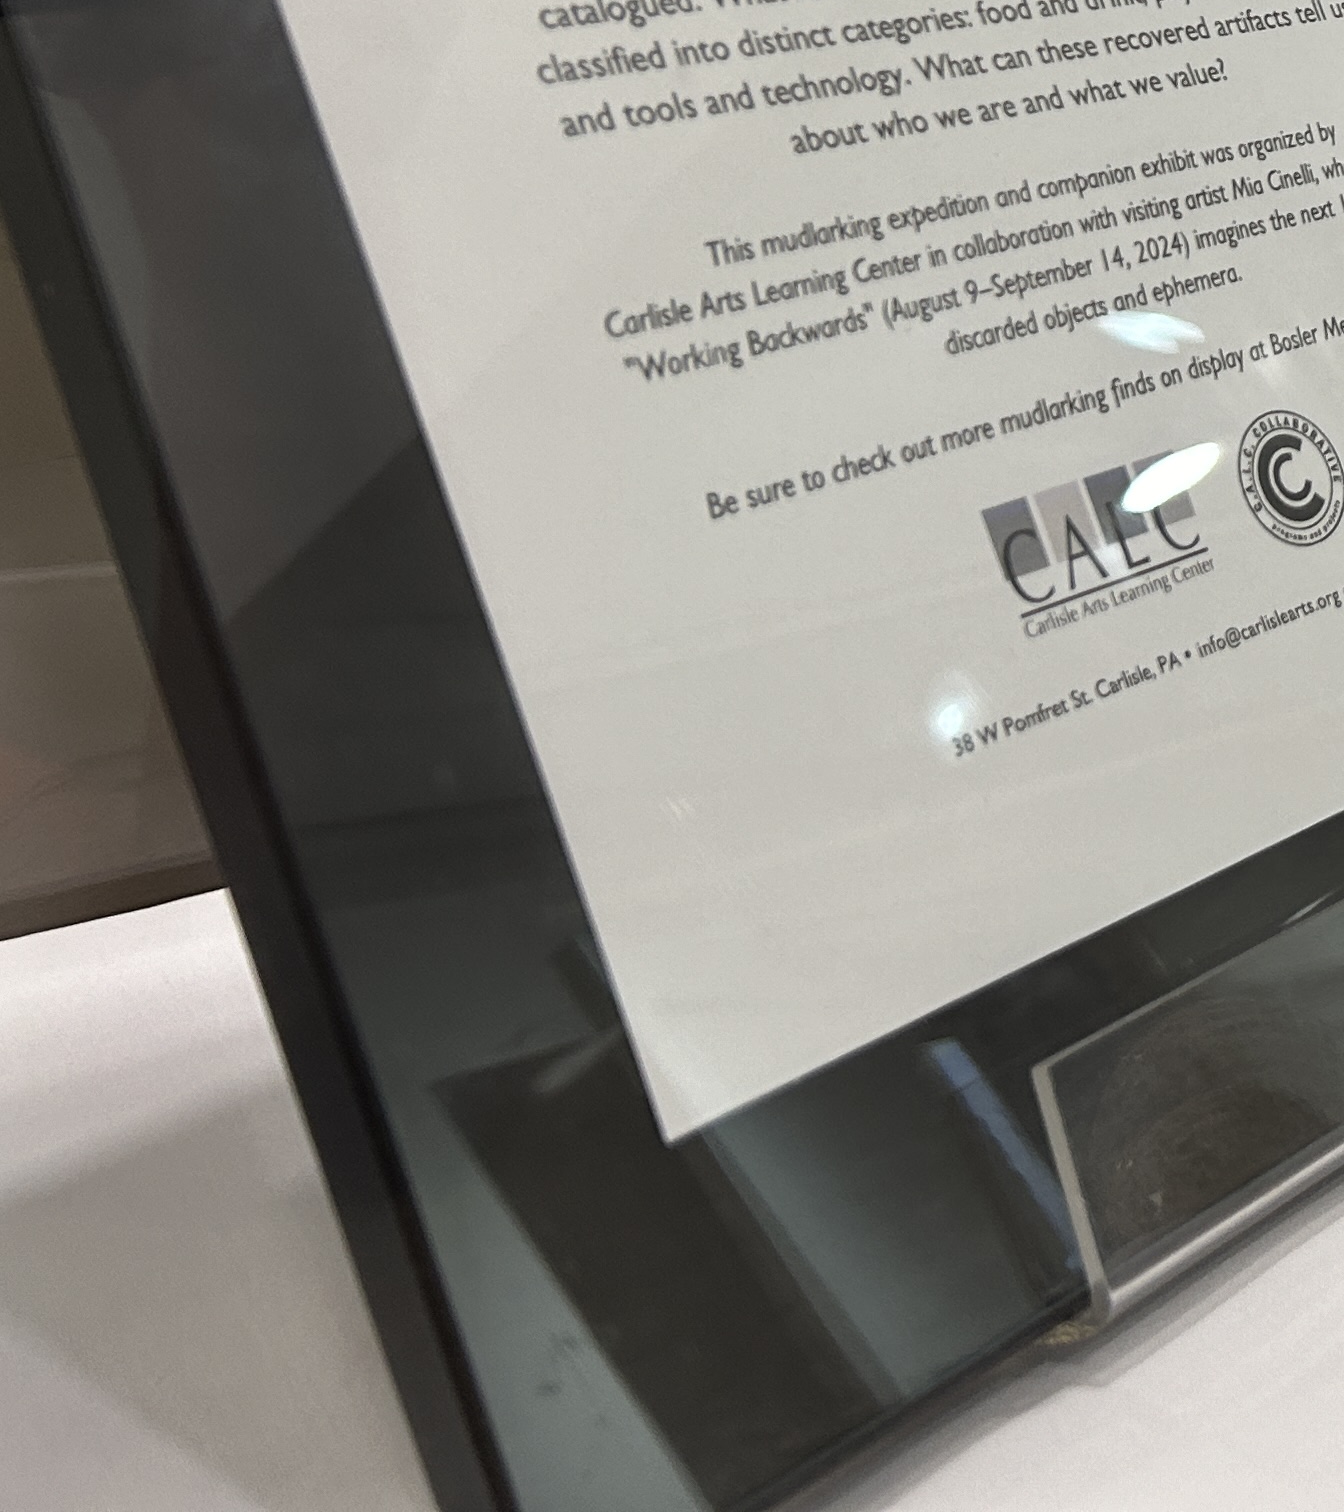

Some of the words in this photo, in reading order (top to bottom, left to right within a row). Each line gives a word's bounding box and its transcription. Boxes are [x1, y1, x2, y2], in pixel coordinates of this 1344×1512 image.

[604, 298, 693, 339] Carlisle
[700, 291, 747, 319] Arts
[751, 270, 850, 306] Learning
[851, 254, 921, 283] Center
[926, 245, 948, 268] in
[952, 220, 1074, 262] collaboration
[1078, 206, 1118, 234] with
[1121, 197, 1183, 224] visiting
[1185, 185, 1229, 211] artist
[1231, 176, 1264, 200] Mia
[1267, 163, 1320, 191] Cinelli,
[703, 237, 756, 267] This
[760, 215, 885, 256] mudlarking
[887, 194, 990, 233] expedition
[994, 179, 1032, 208] and
[1036, 164, 1136, 199] companion
[1140, 149, 1199, 178] exhibit
[1199, 146, 1235, 166] was
[1237, 123, 1315, 161] organized
[1316, 122, 1336, 146] by
[1253, 415, 1341, 482] COLLABORATIVE
[1023, 606, 1079, 638] Carlisle
[1082, 598, 1109, 617] Arts
[1110, 575, 1172, 607] Learning
[1170, 558, 1214, 584] Center
[952, 733, 975, 757] 38
[976, 722, 998, 745] W
[1001, 699, 1070, 737] Pomfret
[1069, 689, 1094, 709] St.
[1094, 665, 1157, 699] Carlisle,
[1156, 651, 1182, 674] PA
[1196, 590, 1343, 658] info@carlislearts.org
